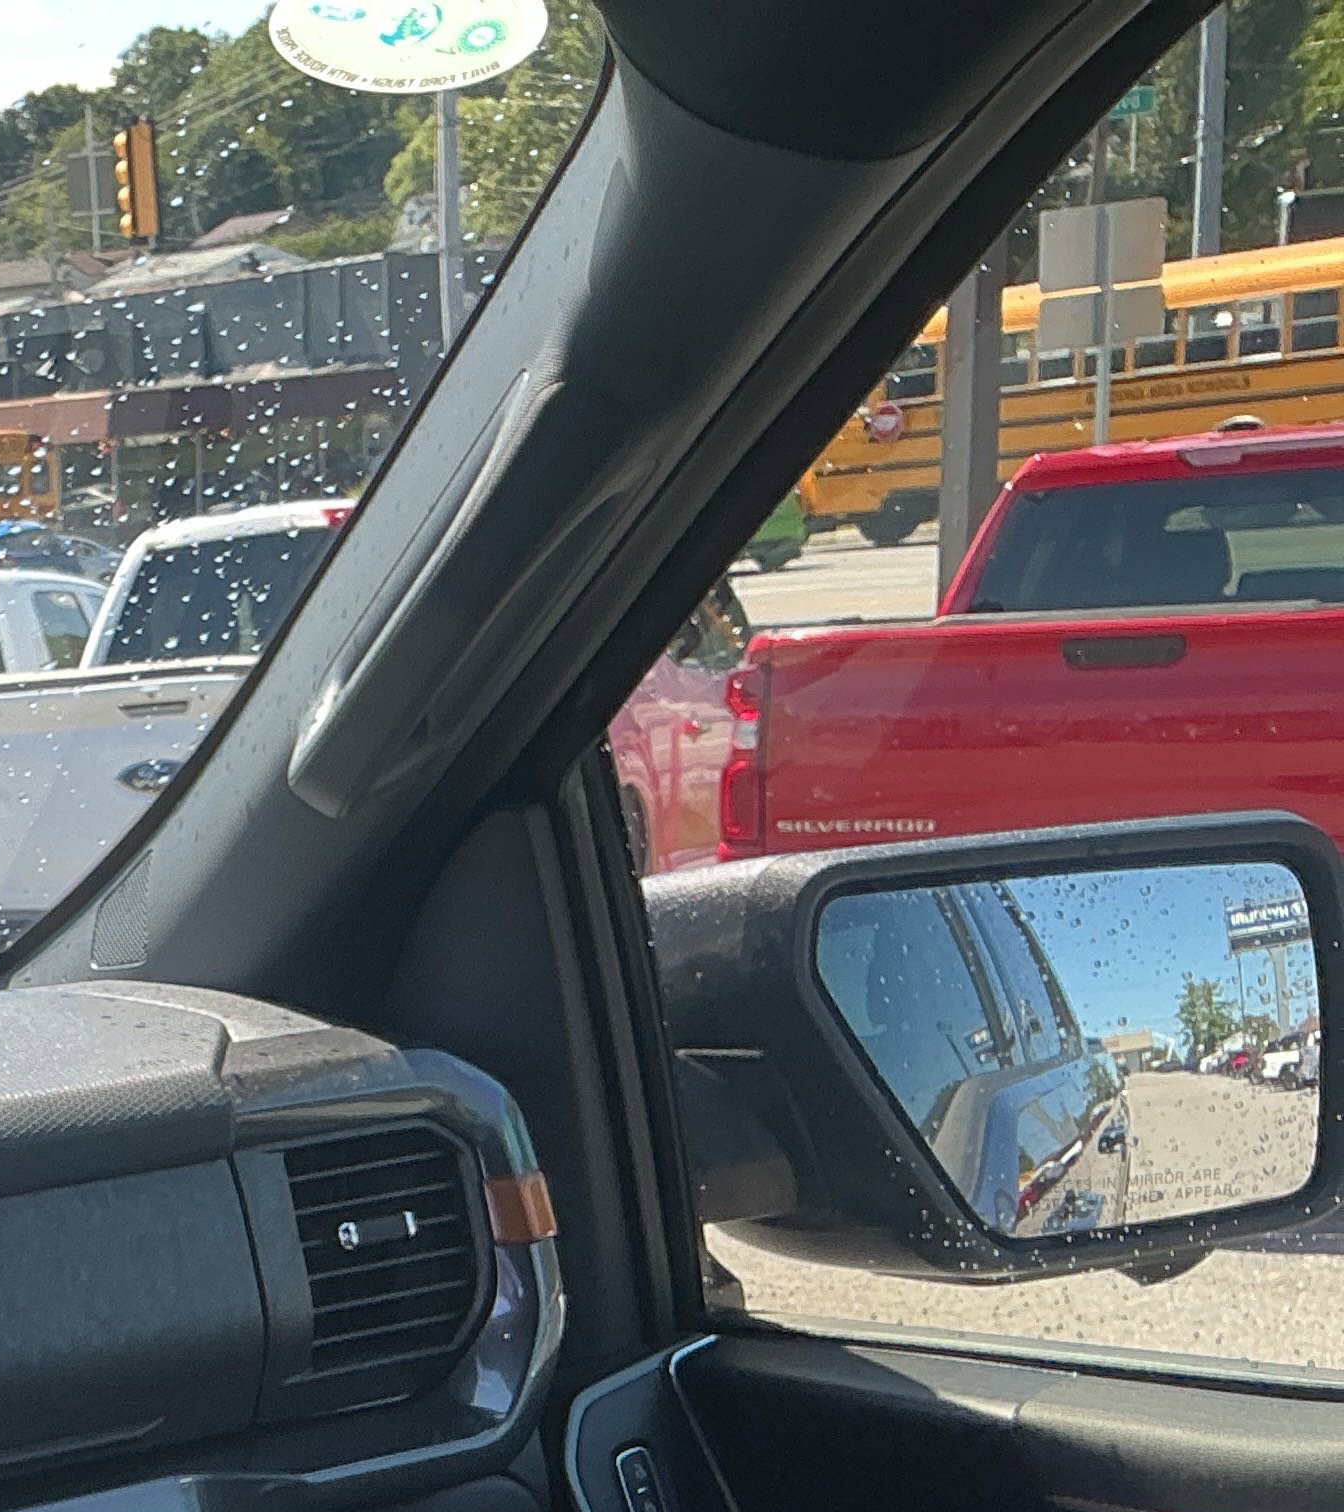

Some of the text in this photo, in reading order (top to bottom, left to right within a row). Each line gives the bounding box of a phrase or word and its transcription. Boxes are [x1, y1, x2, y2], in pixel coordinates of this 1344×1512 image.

[776, 819, 936, 833] SILVERADO
[1128, 1168, 1185, 1187] MIRROR
[1192, 1167, 1222, 1182] ARE
[1174, 1184, 1236, 1200] APPEAR
